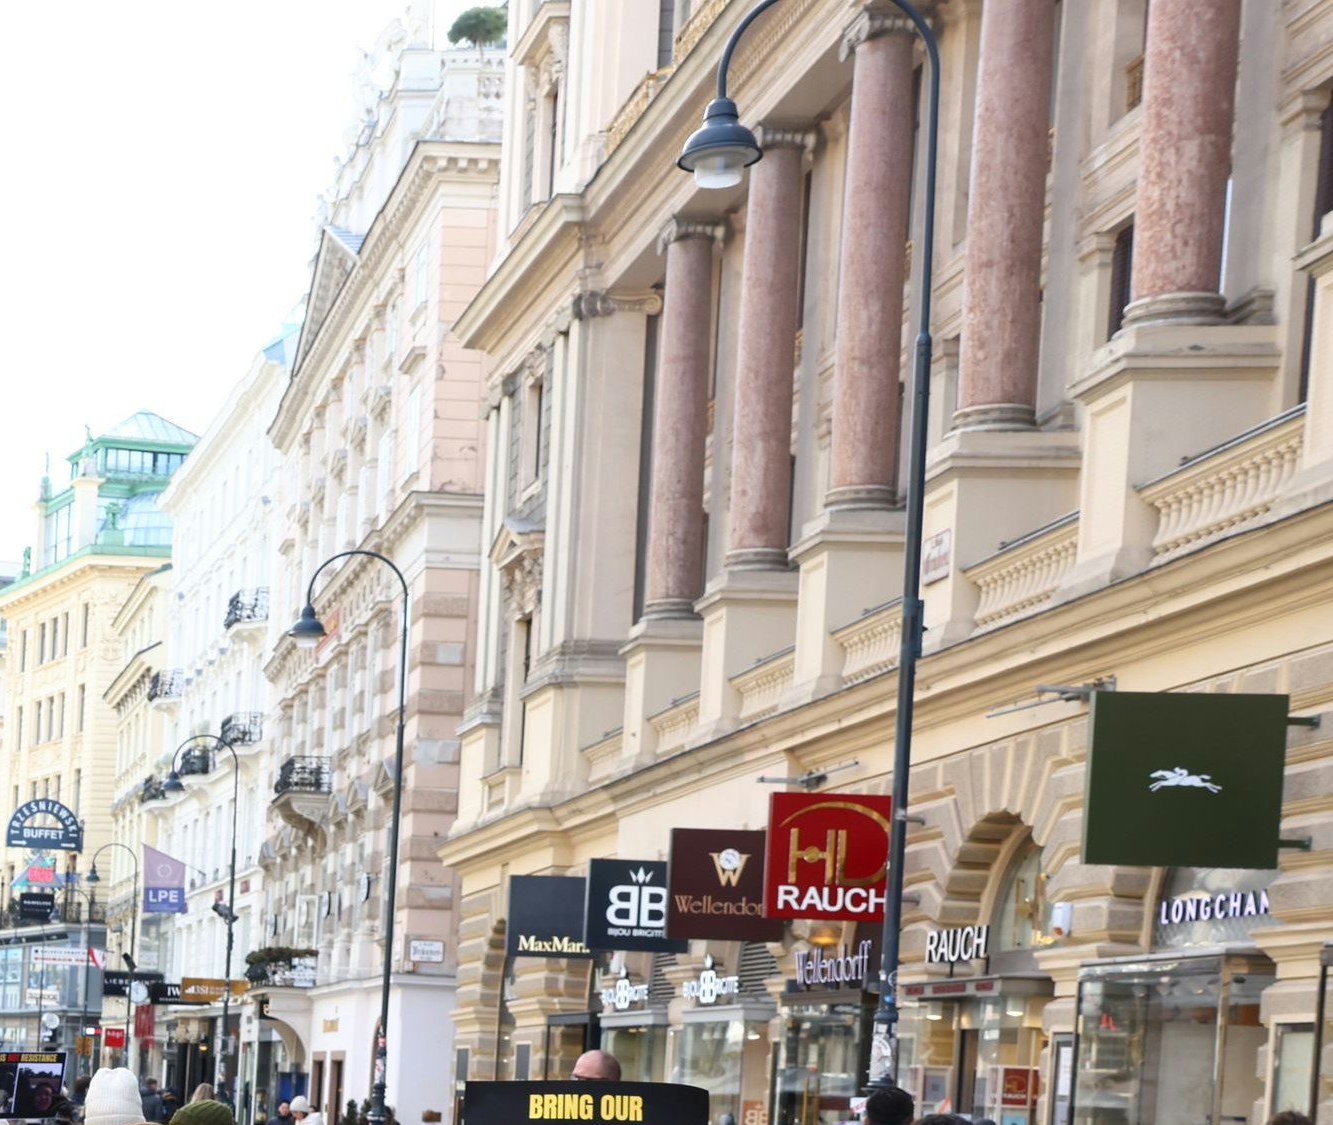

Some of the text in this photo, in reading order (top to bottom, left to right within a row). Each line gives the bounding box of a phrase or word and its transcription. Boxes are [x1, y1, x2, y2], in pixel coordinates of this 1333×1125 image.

[22, 828, 64, 839] BUFFET
[148, 889, 179, 903] LPE
[674, 894, 763, 916] Wellendor
[777, 885, 887, 913] RAUCH
[925, 925, 989, 964] RAUCH
[794, 938, 872, 985] Wellendorff
[528, 1093, 643, 1121] BRING OUR
